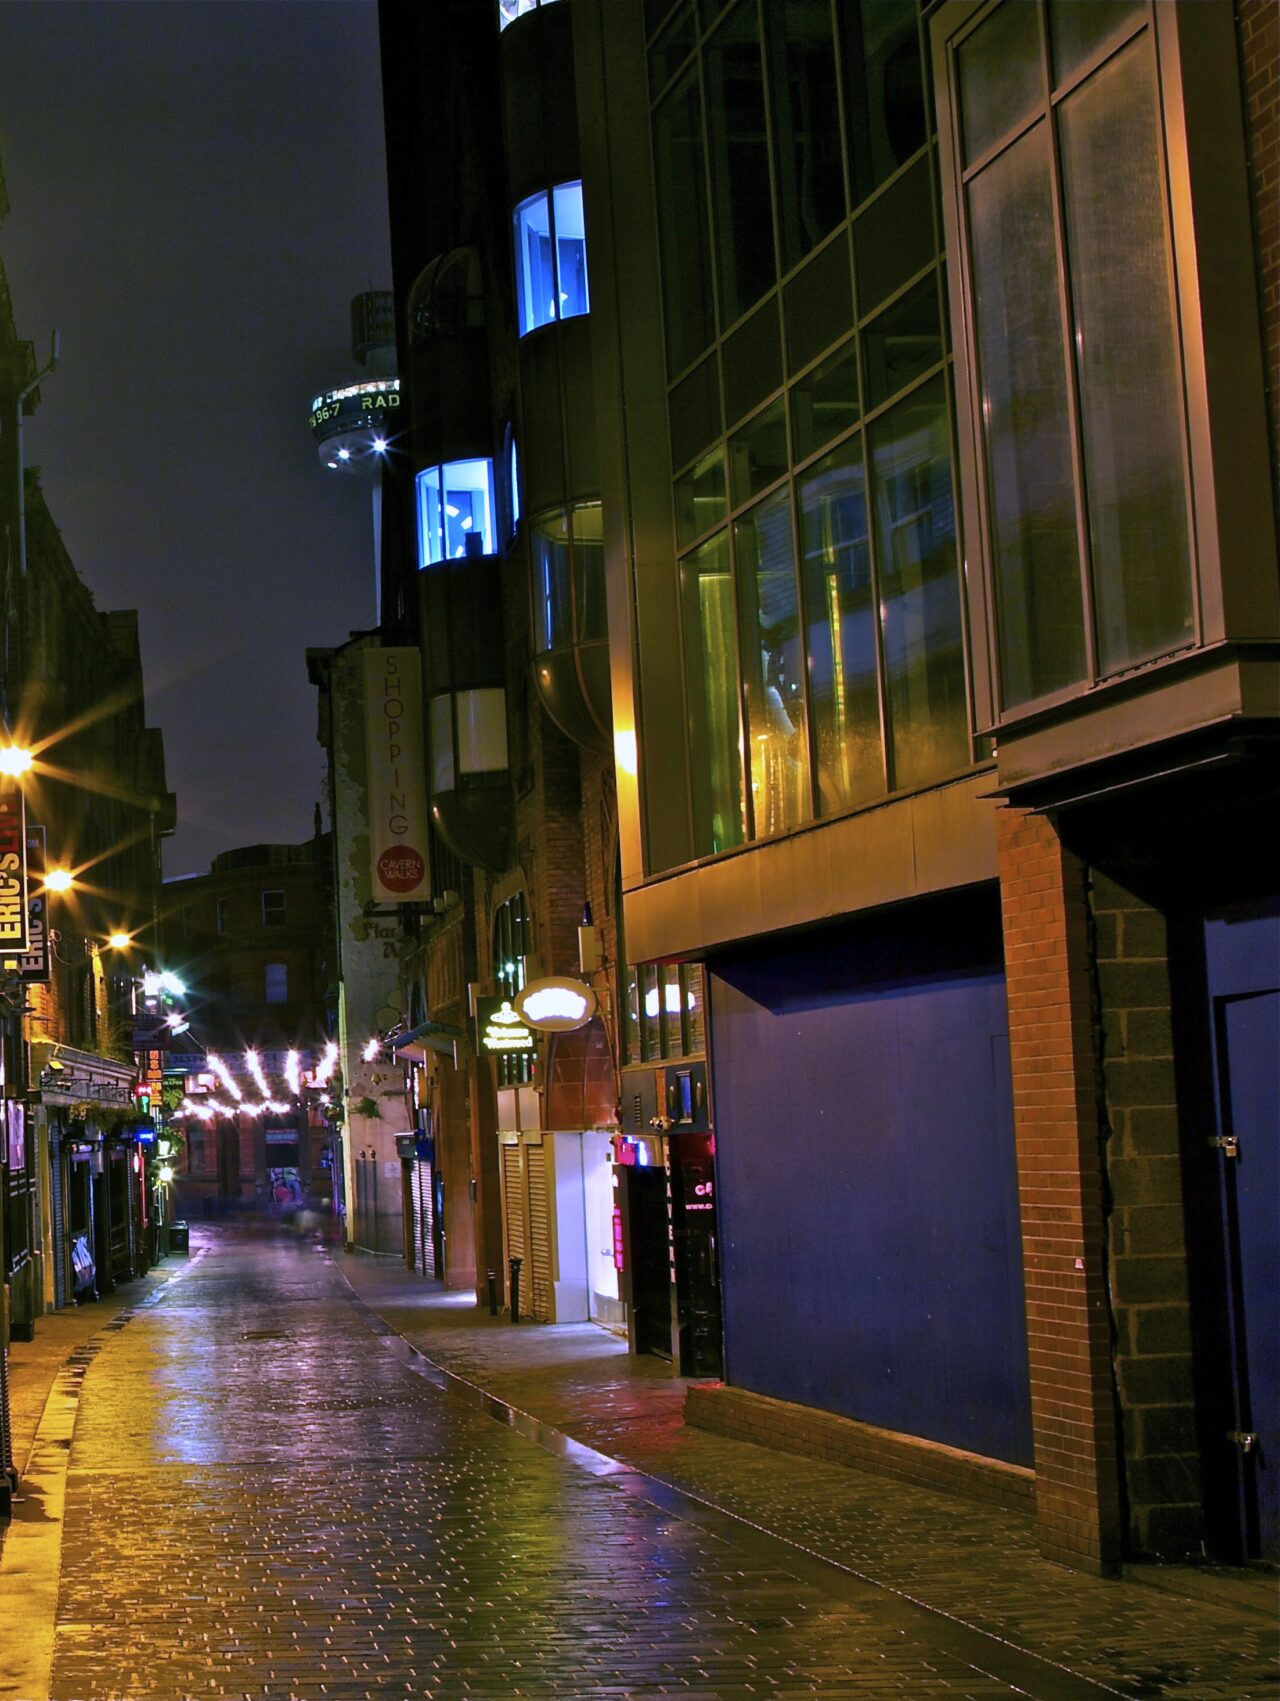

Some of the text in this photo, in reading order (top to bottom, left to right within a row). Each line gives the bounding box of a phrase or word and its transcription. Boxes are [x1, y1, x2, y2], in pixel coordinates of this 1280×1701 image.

[361, 394, 400, 411] RAD
[384, 655, 409, 835] SHOPPING
[380, 859, 420, 870] CAVERN
[384, 869, 419, 880] WALKS
